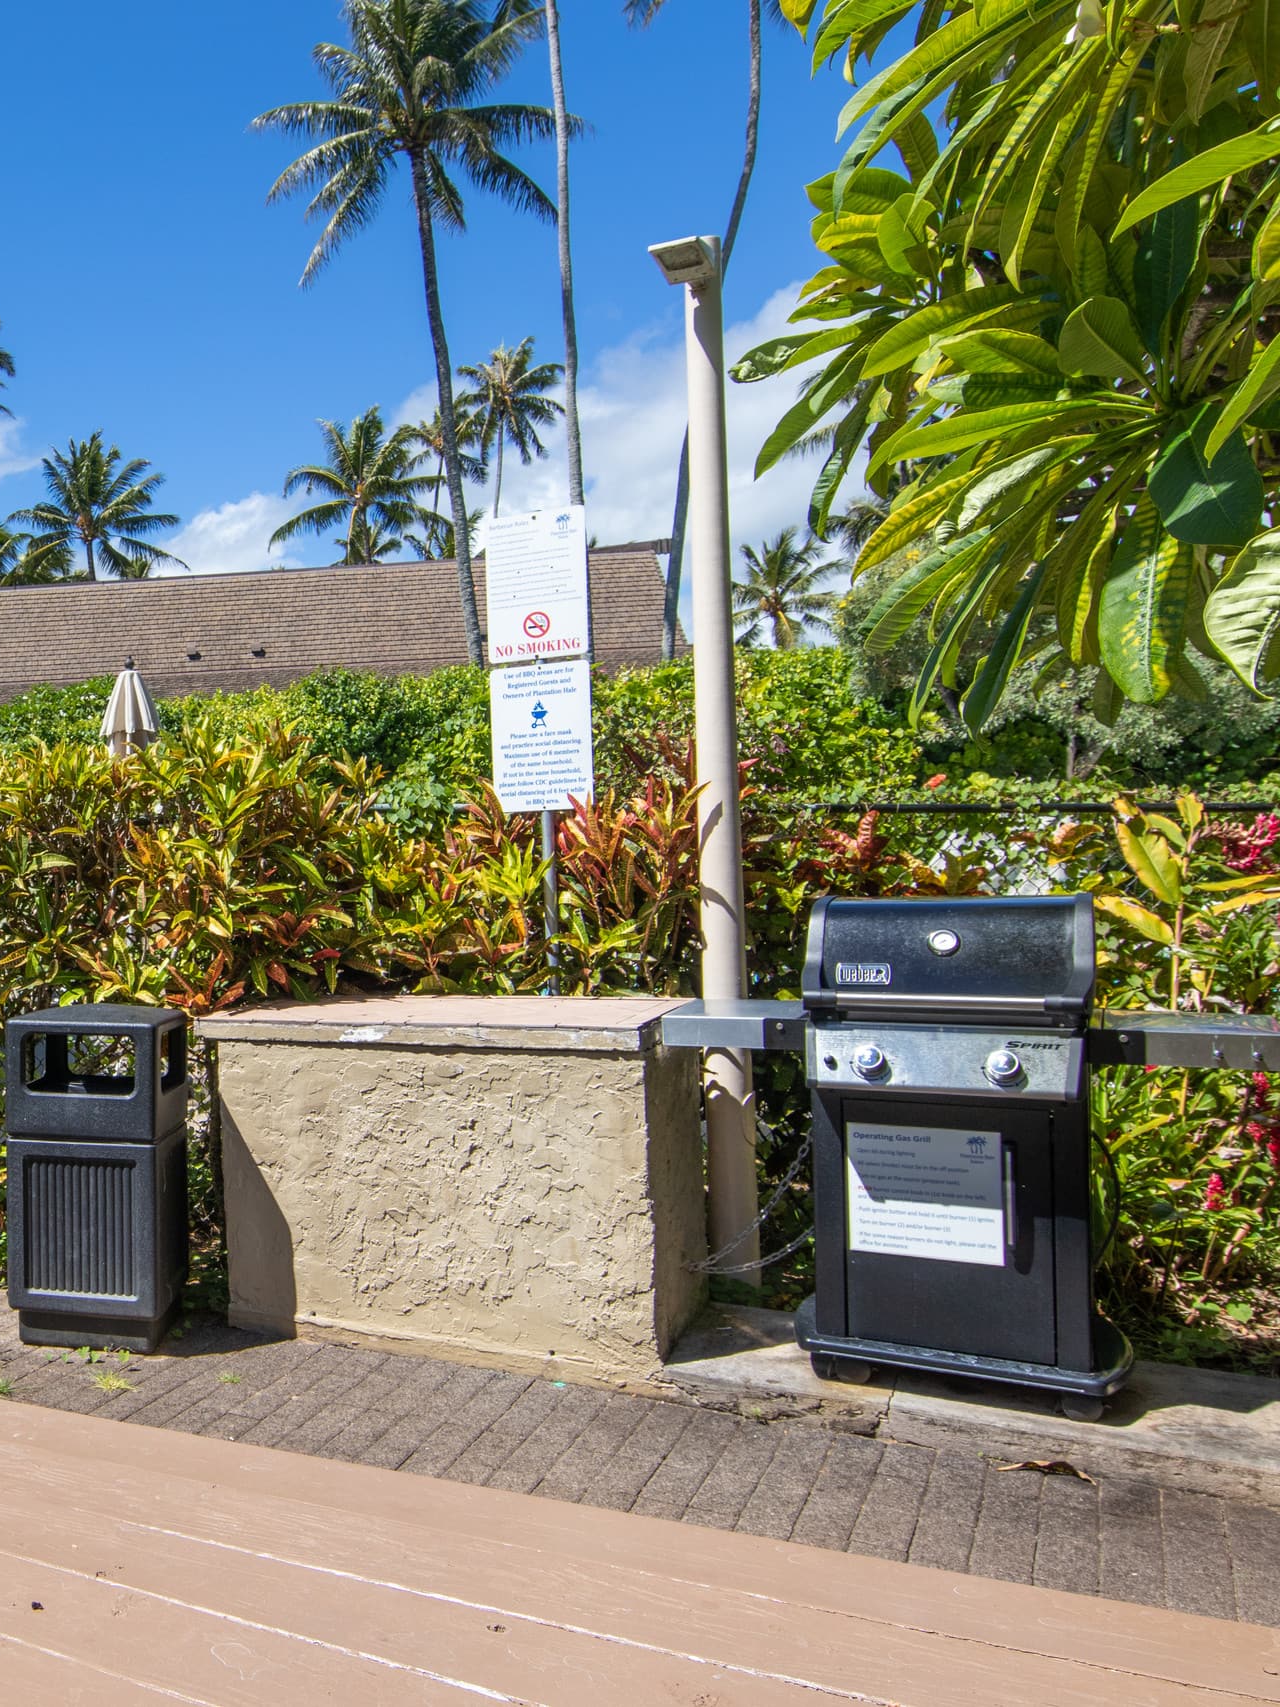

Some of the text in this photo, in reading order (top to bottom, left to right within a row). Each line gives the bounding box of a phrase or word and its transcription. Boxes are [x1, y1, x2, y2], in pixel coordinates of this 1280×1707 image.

[495, 637, 581, 658] NO SMOKING
[508, 680, 537, 689] Registered
[840, 963, 880, 983] weber
[852, 1131, 932, 1144] Operating Gas Grill
